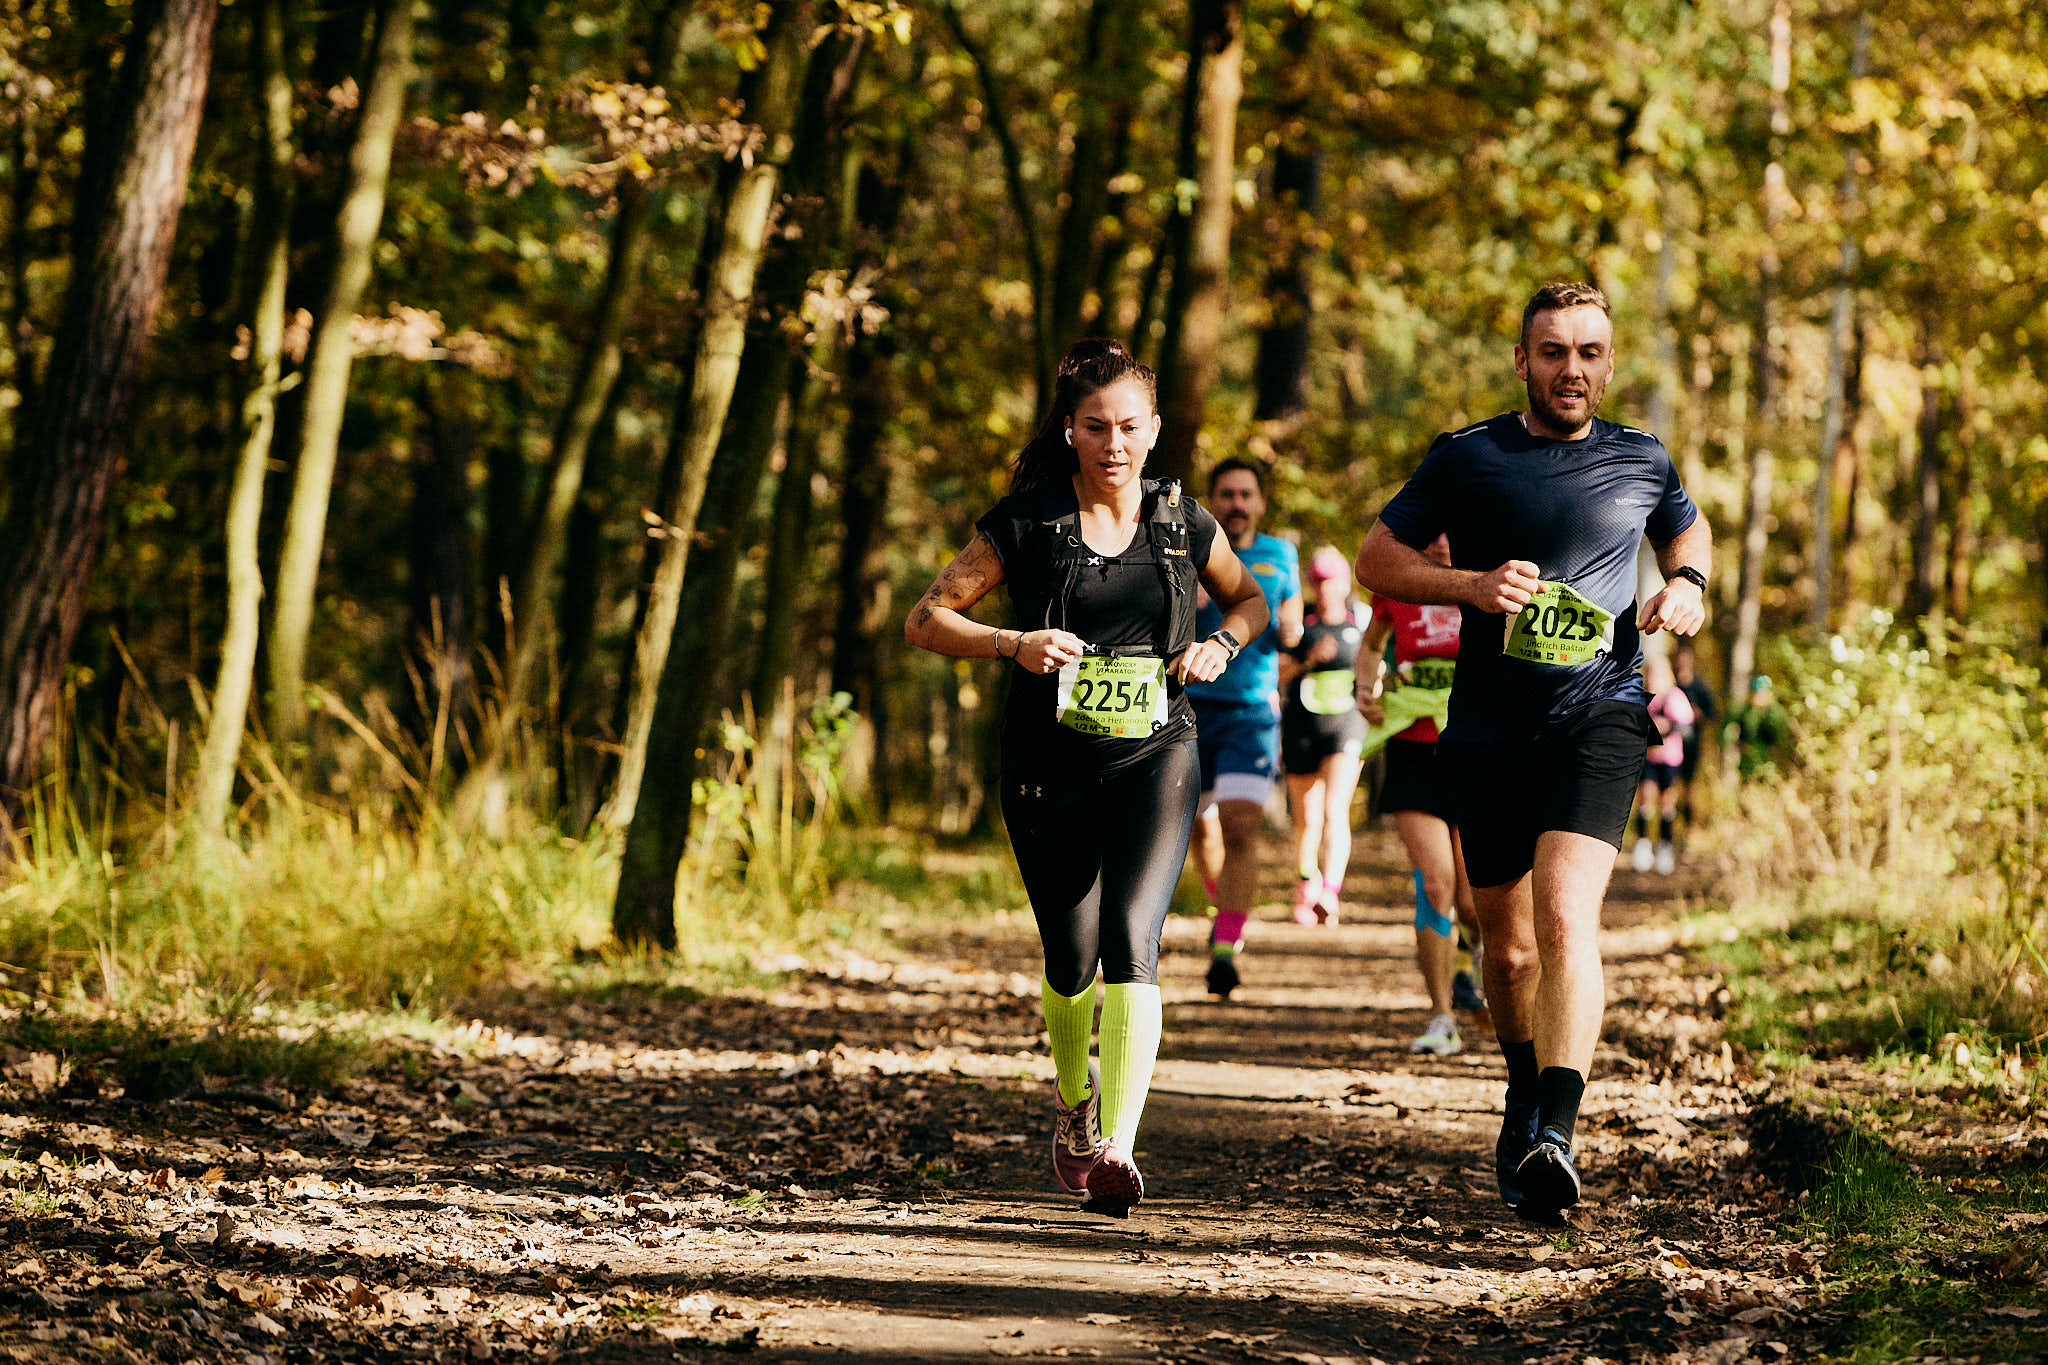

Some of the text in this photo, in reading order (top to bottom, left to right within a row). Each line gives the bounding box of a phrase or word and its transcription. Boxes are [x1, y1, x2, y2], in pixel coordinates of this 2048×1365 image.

[1522, 603, 1597, 642] 2025
[1519, 648, 1532, 658] 1/2
[1076, 679, 1150, 713] 2254
